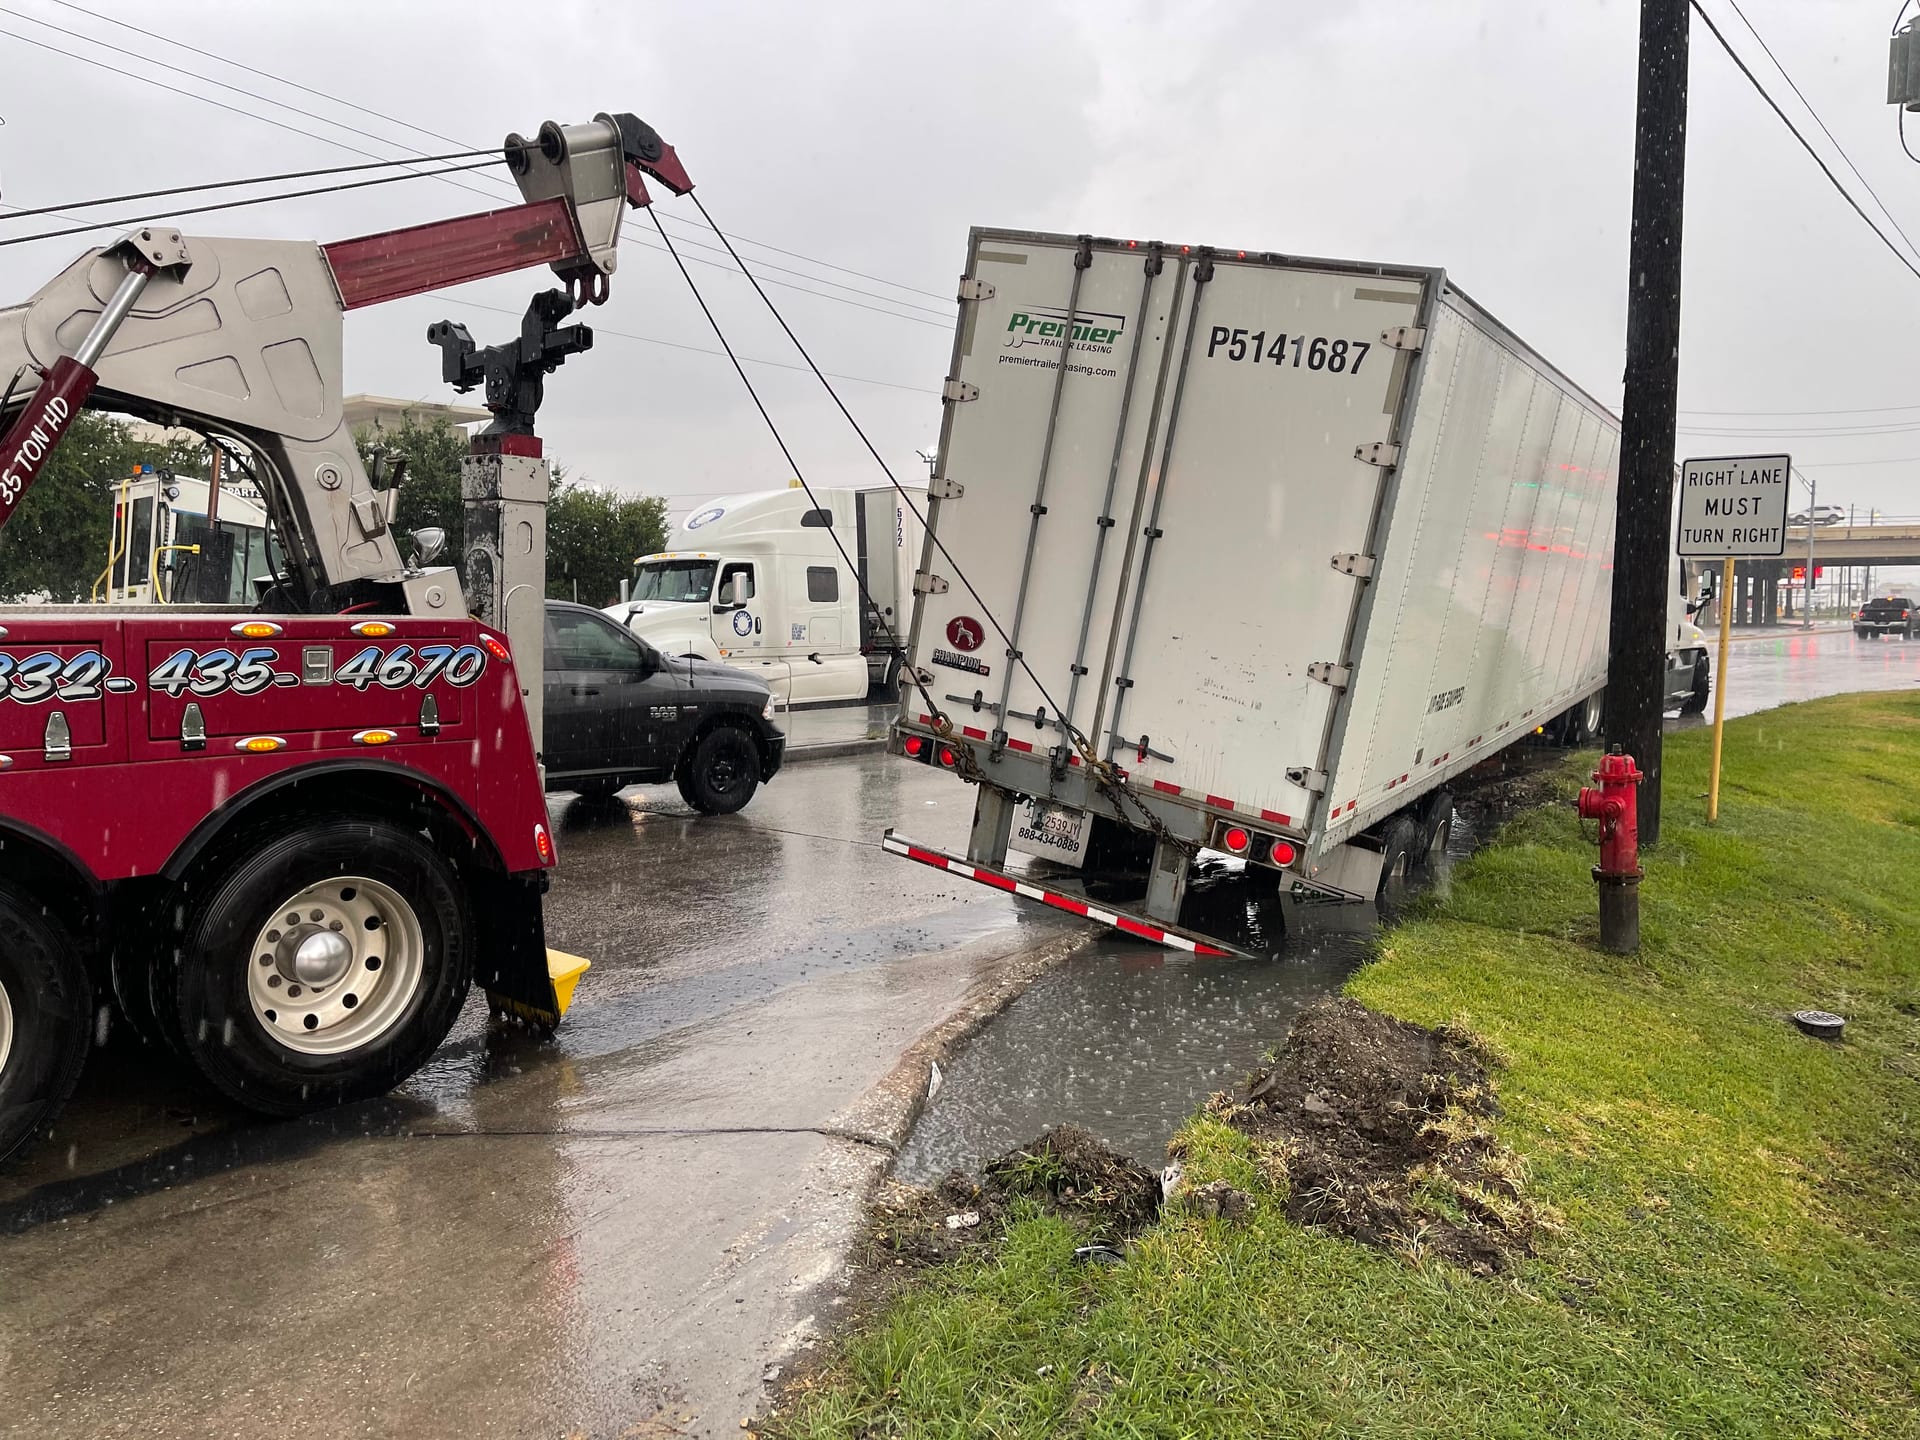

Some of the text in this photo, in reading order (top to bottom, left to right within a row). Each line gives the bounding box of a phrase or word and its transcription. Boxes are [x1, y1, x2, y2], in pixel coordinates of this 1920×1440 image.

[1007, 313, 1123, 344] Premier
[1040, 338, 1112, 354] TRAILR LEASING
[1207, 326, 1371, 375] P5141687
[999, 354, 1116, 377] premiertrailereasing.com
[0, 396, 69, 505] 35 TON HD
[1689, 469, 1782, 486] RIGHT LANE
[227, 487, 262, 498] PARTS
[1705, 497, 1762, 516] MUST
[1684, 528, 1779, 543] TURN RIGHT
[335, 644, 487, 691] 4670
[932, 648, 982, 669] CHAMPION
[1018, 827, 1080, 852] 888-434-0889
